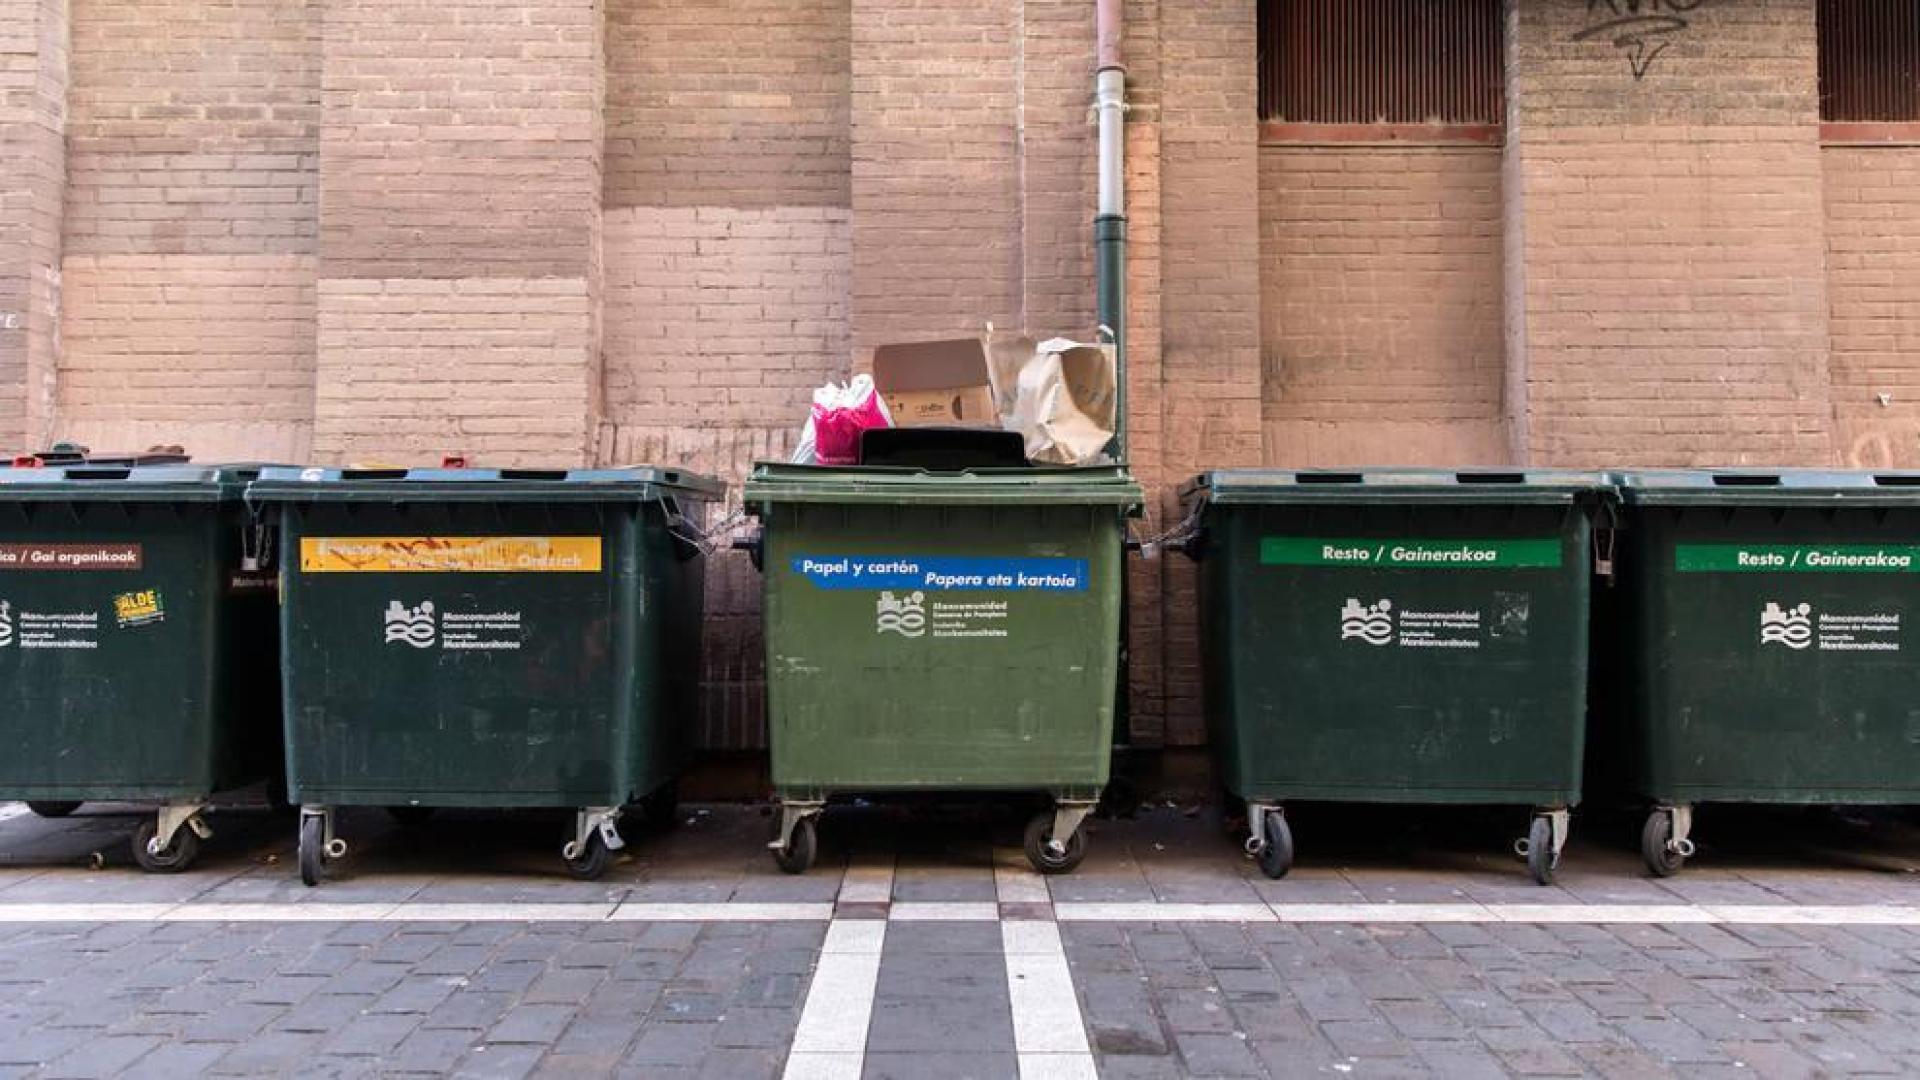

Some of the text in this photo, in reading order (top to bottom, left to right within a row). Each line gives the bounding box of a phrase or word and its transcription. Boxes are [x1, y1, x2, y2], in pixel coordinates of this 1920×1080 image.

[30, 550, 55, 563] Gai
[57, 550, 137, 565] organikoak
[1322, 545, 1497, 563] Resto / Gainerakoa
[1737, 550, 1911, 568] Resto / Gainerakoa
[803, 559, 918, 577] Papel y cartón
[924, 571, 1077, 589] Papera eta kartoia
